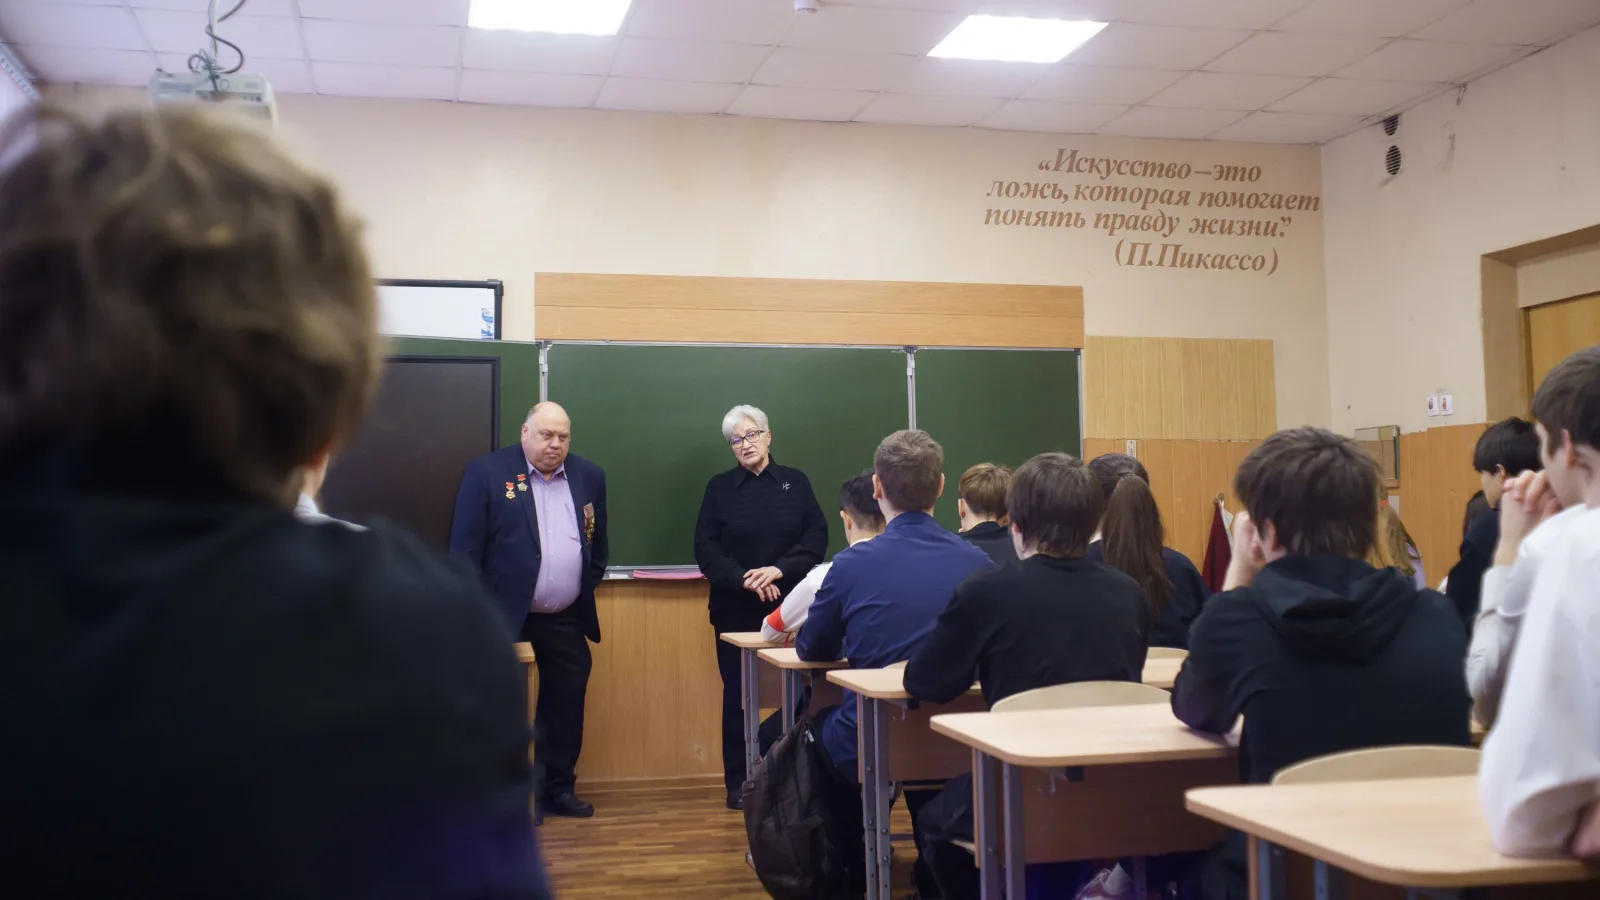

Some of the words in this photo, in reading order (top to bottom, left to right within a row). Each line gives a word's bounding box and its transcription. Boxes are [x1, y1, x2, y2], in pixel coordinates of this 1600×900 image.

[986, 181, 1069, 204] ложь,
[1074, 183, 1191, 211] которая
[1198, 190, 1321, 212] помогает
[984, 208, 1086, 229] понять
[1093, 212, 1180, 238] правду
